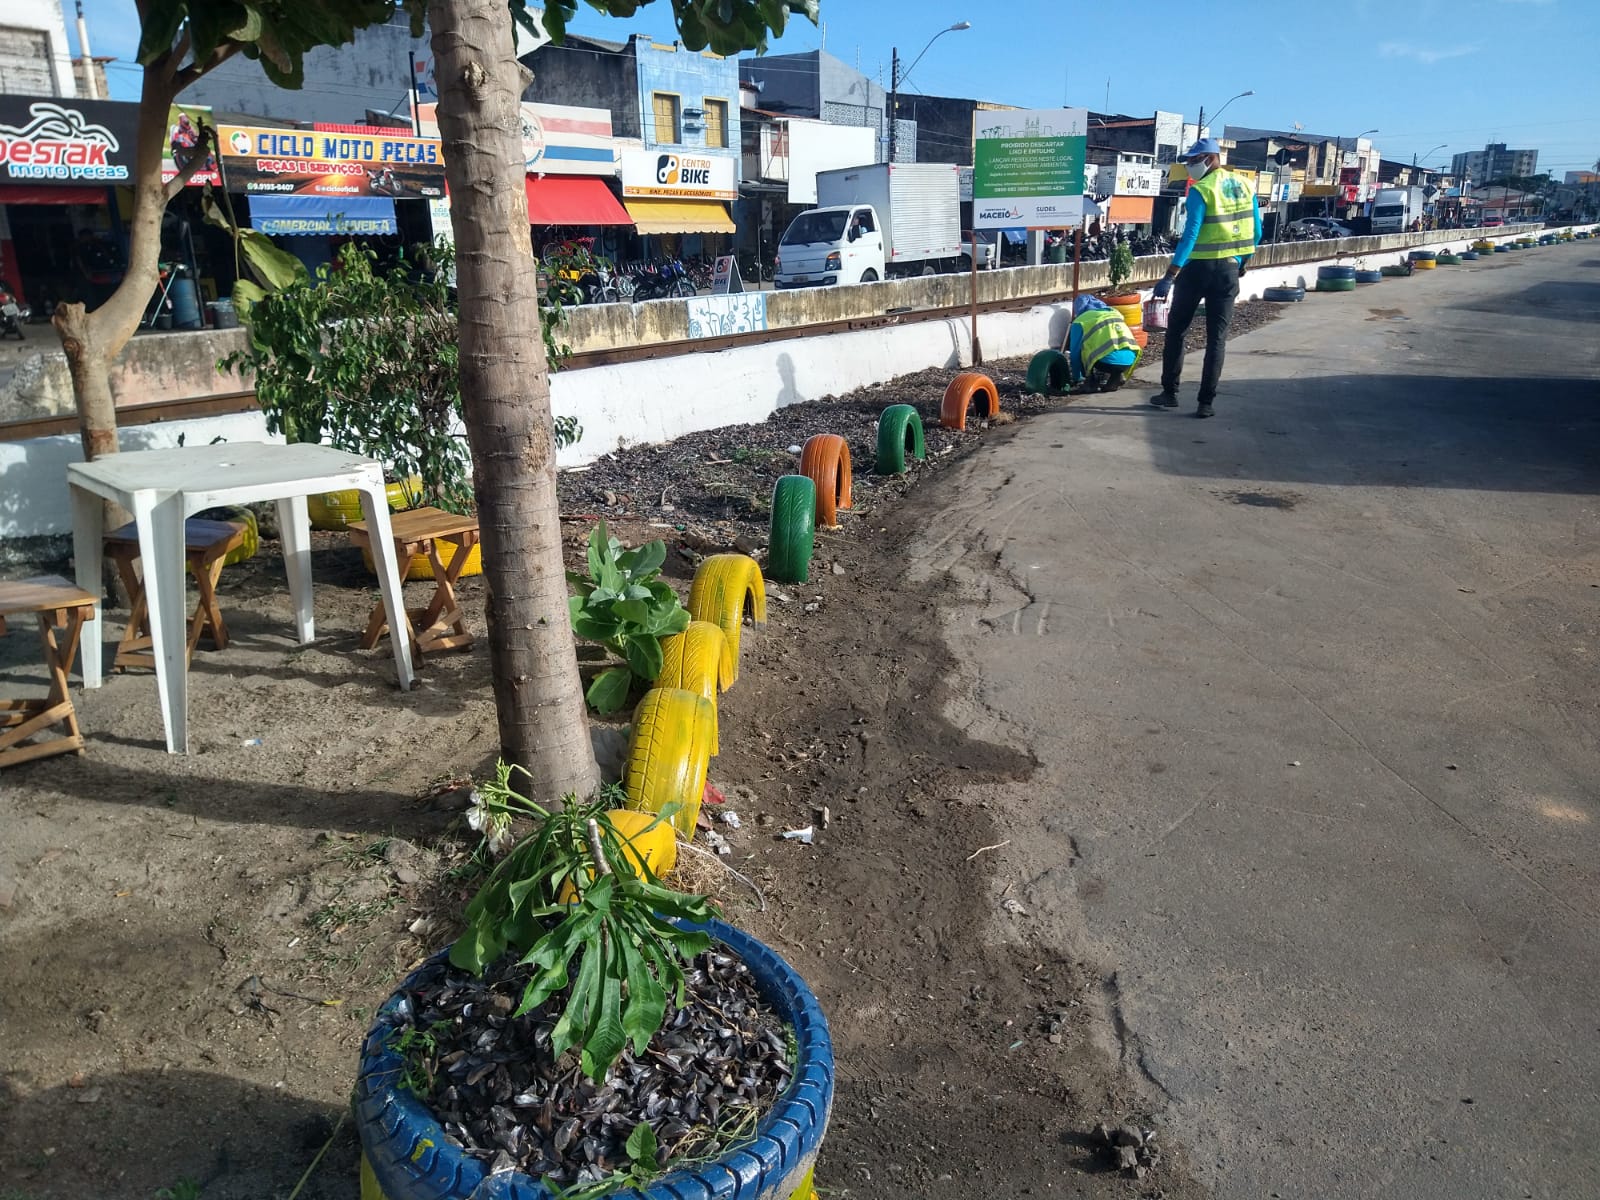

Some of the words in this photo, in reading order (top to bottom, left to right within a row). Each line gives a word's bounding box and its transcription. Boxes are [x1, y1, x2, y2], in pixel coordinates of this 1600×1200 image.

[257, 134, 314, 157] CICLO
[322, 138, 374, 160] MOTO
[257, 159, 296, 174] PEÇAS
[298, 161, 309, 172] E
[310, 161, 364, 175] SERVIÇOS
[681, 158, 711, 169] CENTRO
[681, 168, 710, 184] BIKE
[979, 210, 1011, 219] MACEIÓ
